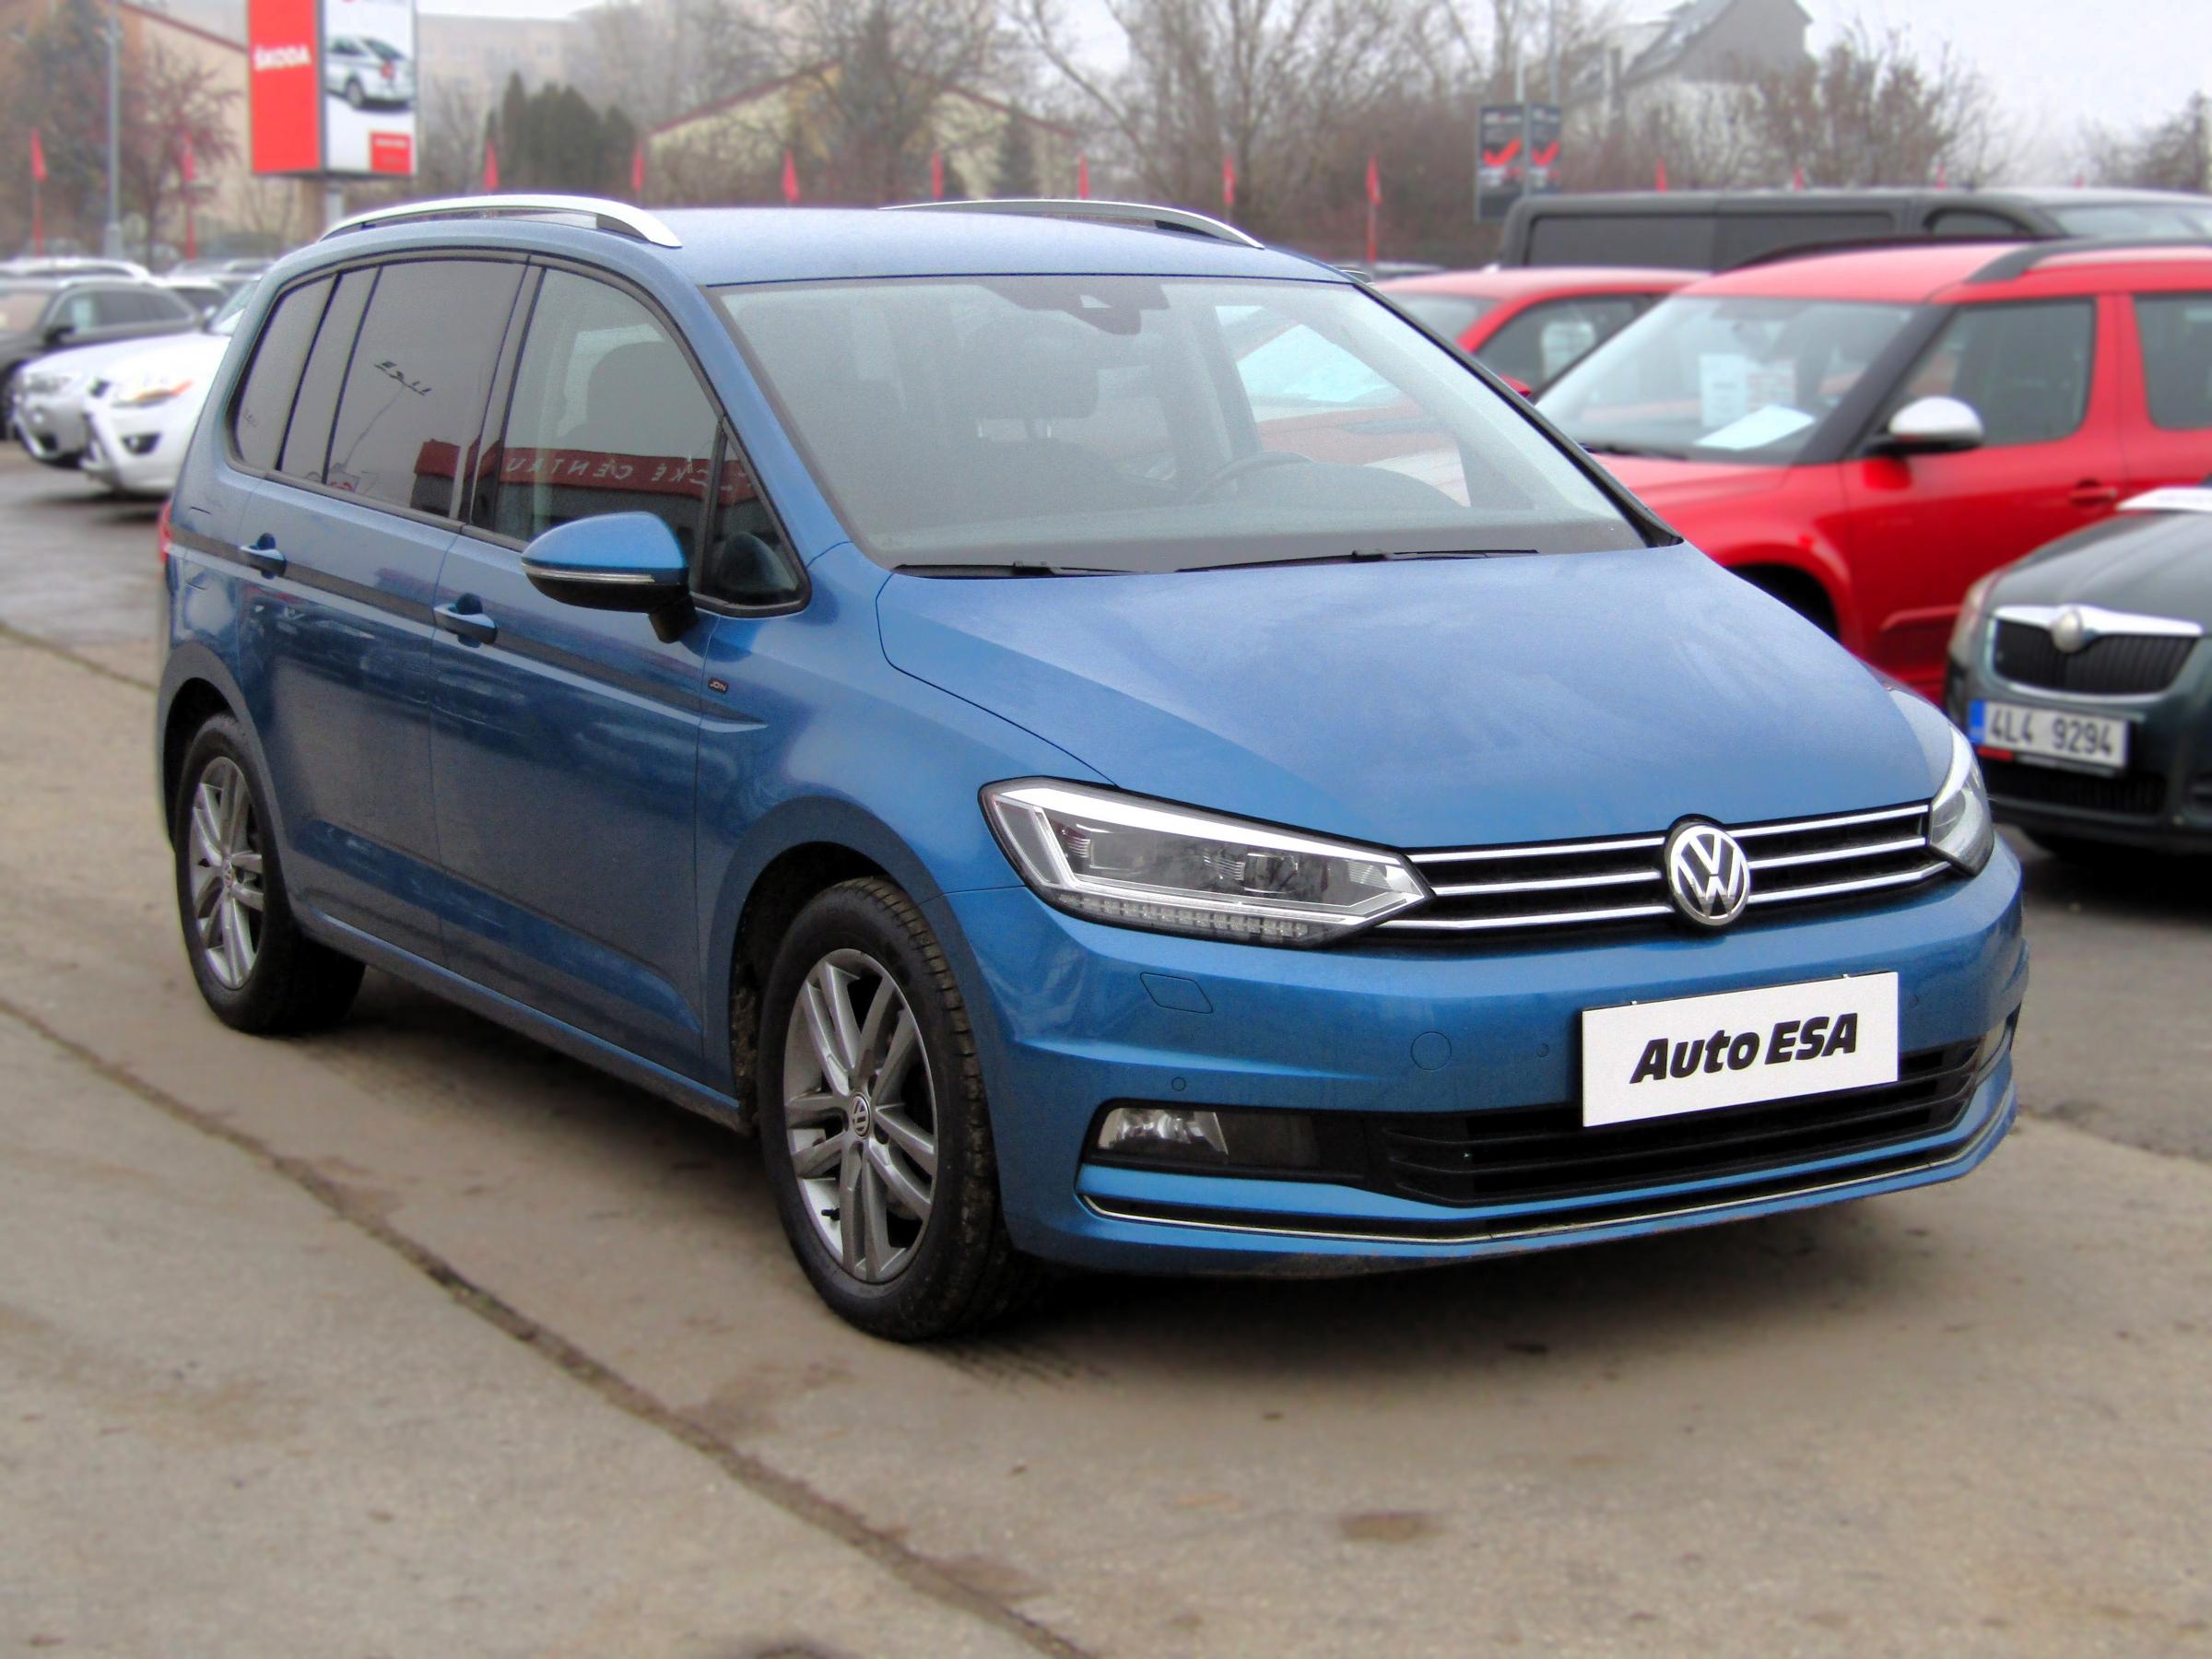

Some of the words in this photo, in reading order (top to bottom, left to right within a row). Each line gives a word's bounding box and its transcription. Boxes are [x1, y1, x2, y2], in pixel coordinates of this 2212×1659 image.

[1989, 709, 2034, 745] 4L4
[2052, 717, 2113, 757] 9294
[1629, 1029, 1760, 1084] Auto
[1764, 1012, 1858, 1065] ESA
